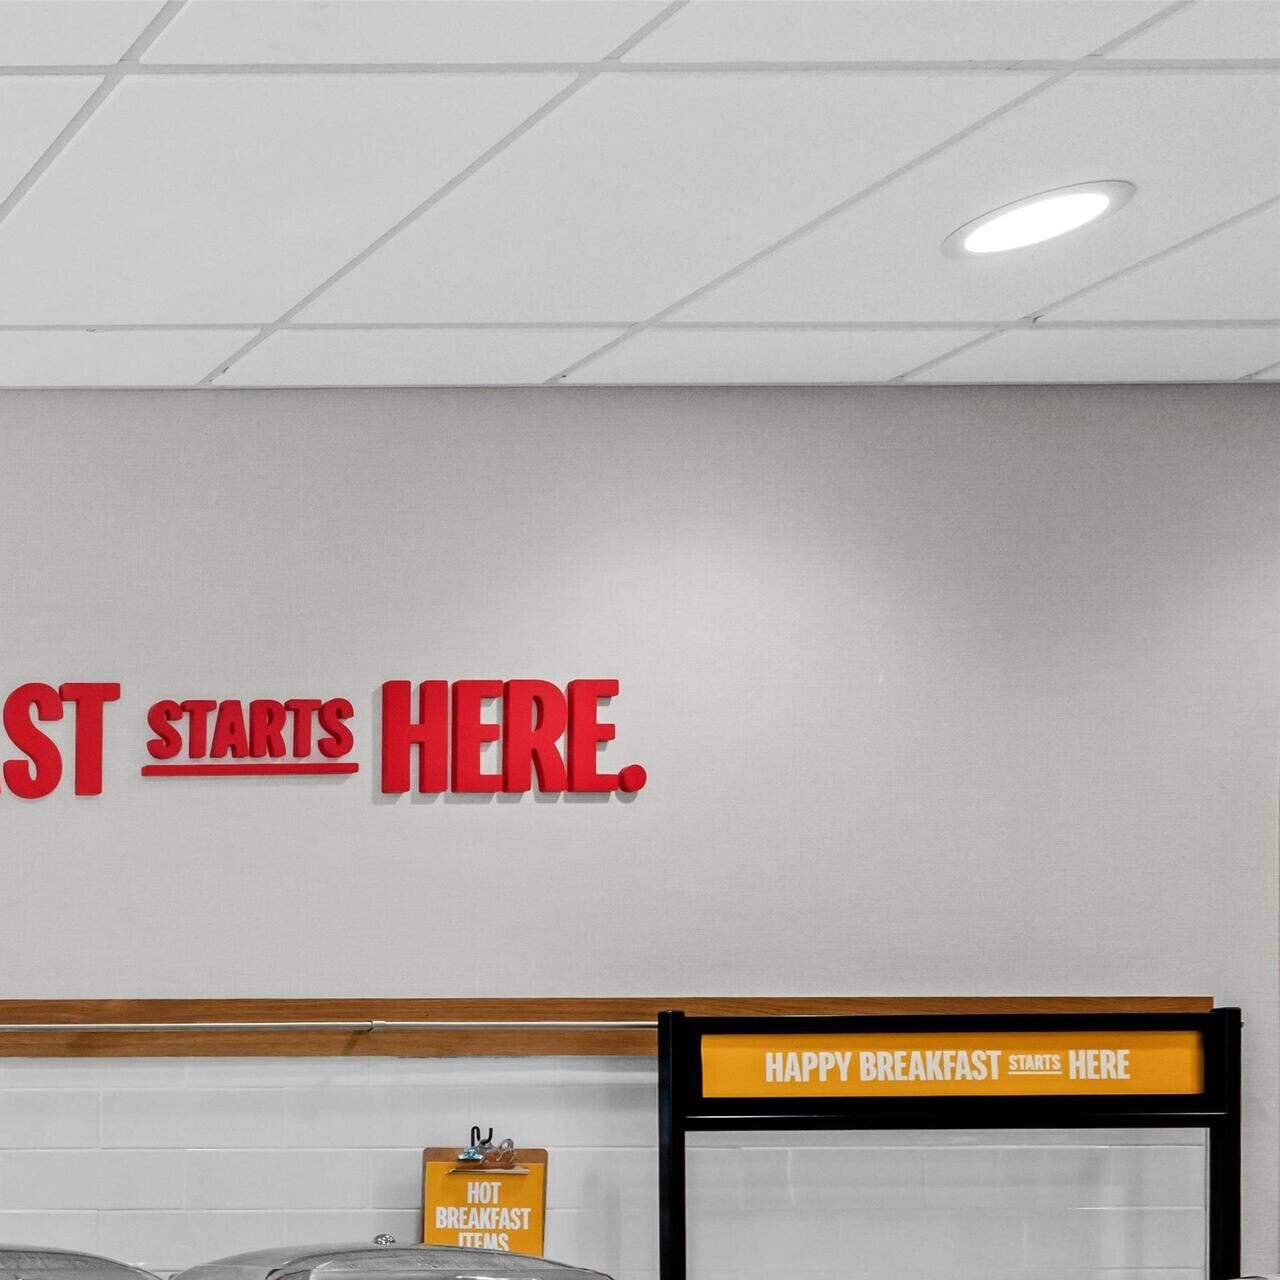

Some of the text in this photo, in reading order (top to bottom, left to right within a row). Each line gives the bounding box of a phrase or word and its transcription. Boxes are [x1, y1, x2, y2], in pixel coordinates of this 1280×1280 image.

[146, 698, 354, 760] STARTS
[381, 679, 648, 794] HERE.
[765, 1048, 1131, 1083] HAPPY BREAKFAST STARTS HERE
[466, 1181, 502, 1204] HOT
[435, 1206, 532, 1231] BREAKFAST
[458, 1231, 511, 1251] ITEMS
